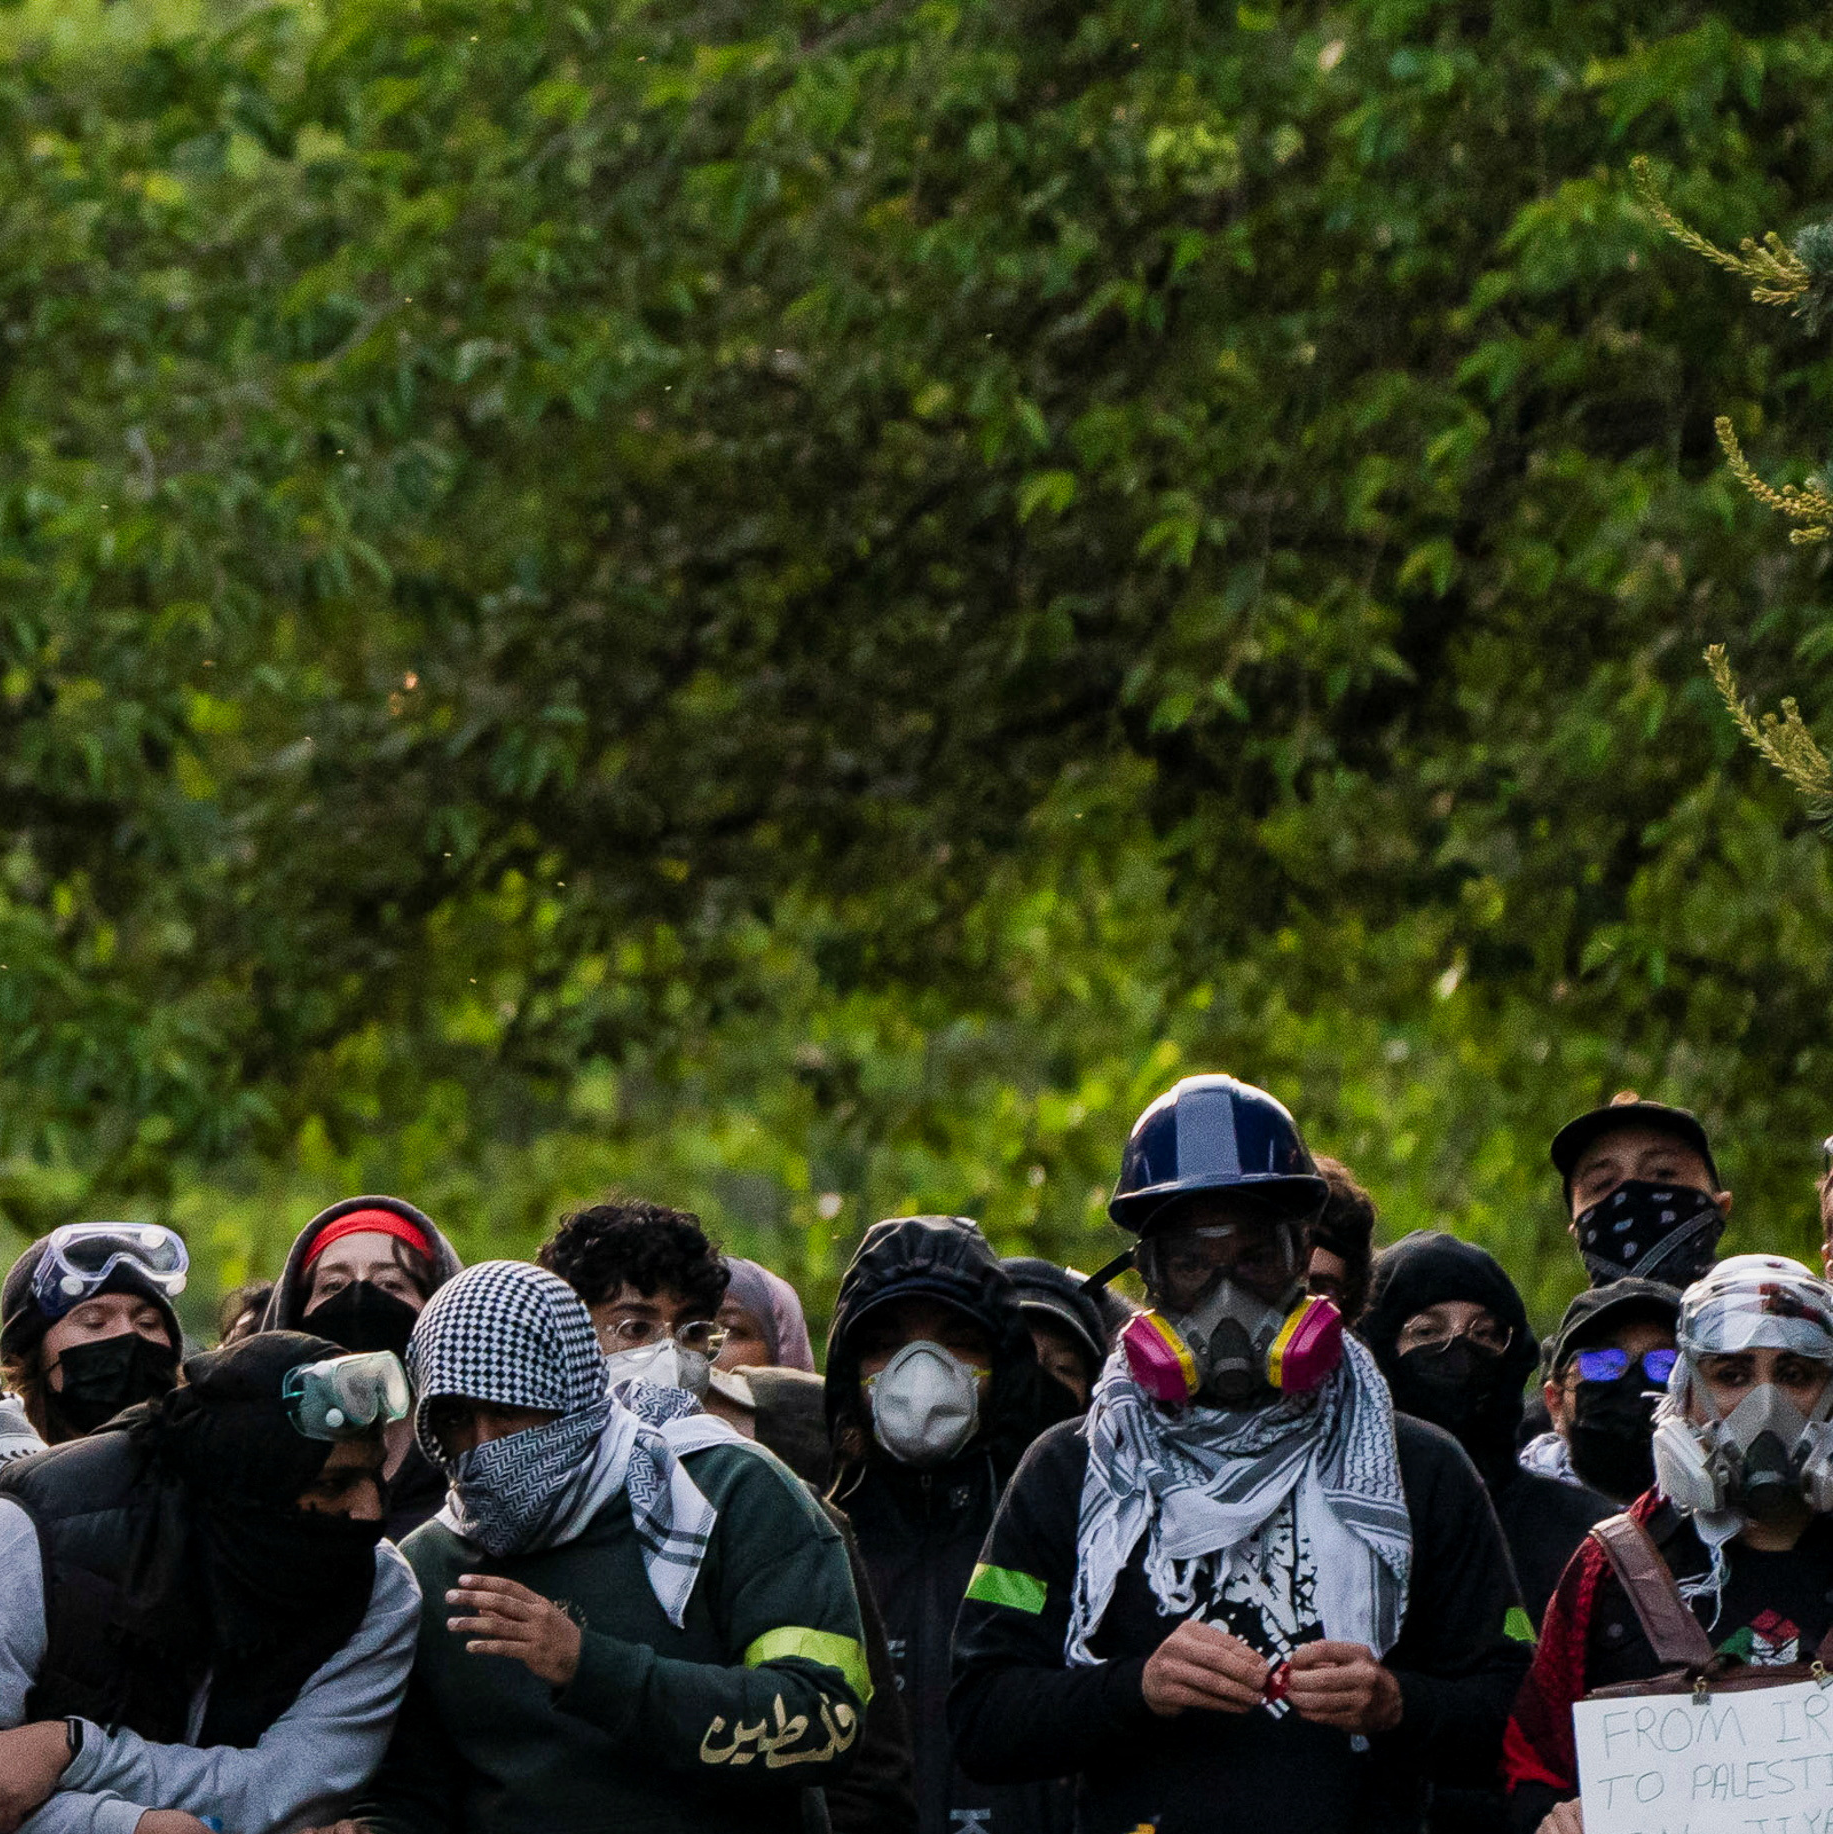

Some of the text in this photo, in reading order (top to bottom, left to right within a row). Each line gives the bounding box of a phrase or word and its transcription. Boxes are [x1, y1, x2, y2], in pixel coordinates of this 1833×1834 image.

[699, 1693, 858, 1769] فلسطين
[1602, 1705, 1747, 1758] FROM
[1597, 1771, 1665, 1810] TO
